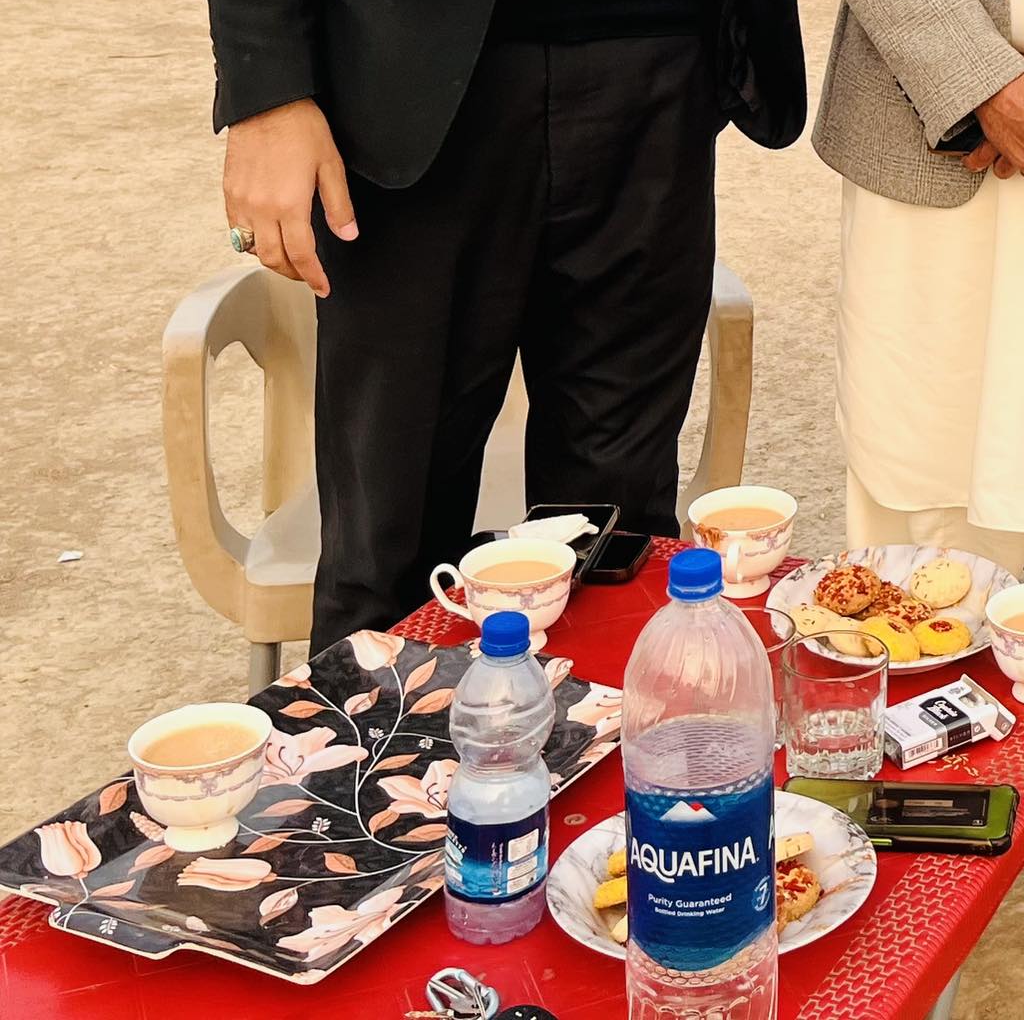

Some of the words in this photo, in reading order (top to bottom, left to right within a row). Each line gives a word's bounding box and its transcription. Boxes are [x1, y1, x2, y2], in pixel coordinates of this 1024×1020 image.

[630, 836, 757, 883] AQUAFINA
[648, 893, 674, 909] Purity
[675, 892, 733, 909] Guaranteed
[654, 907, 675, 916] Bottled
[676, 909, 705, 918] Drinking
[705, 906, 725, 916] Water
